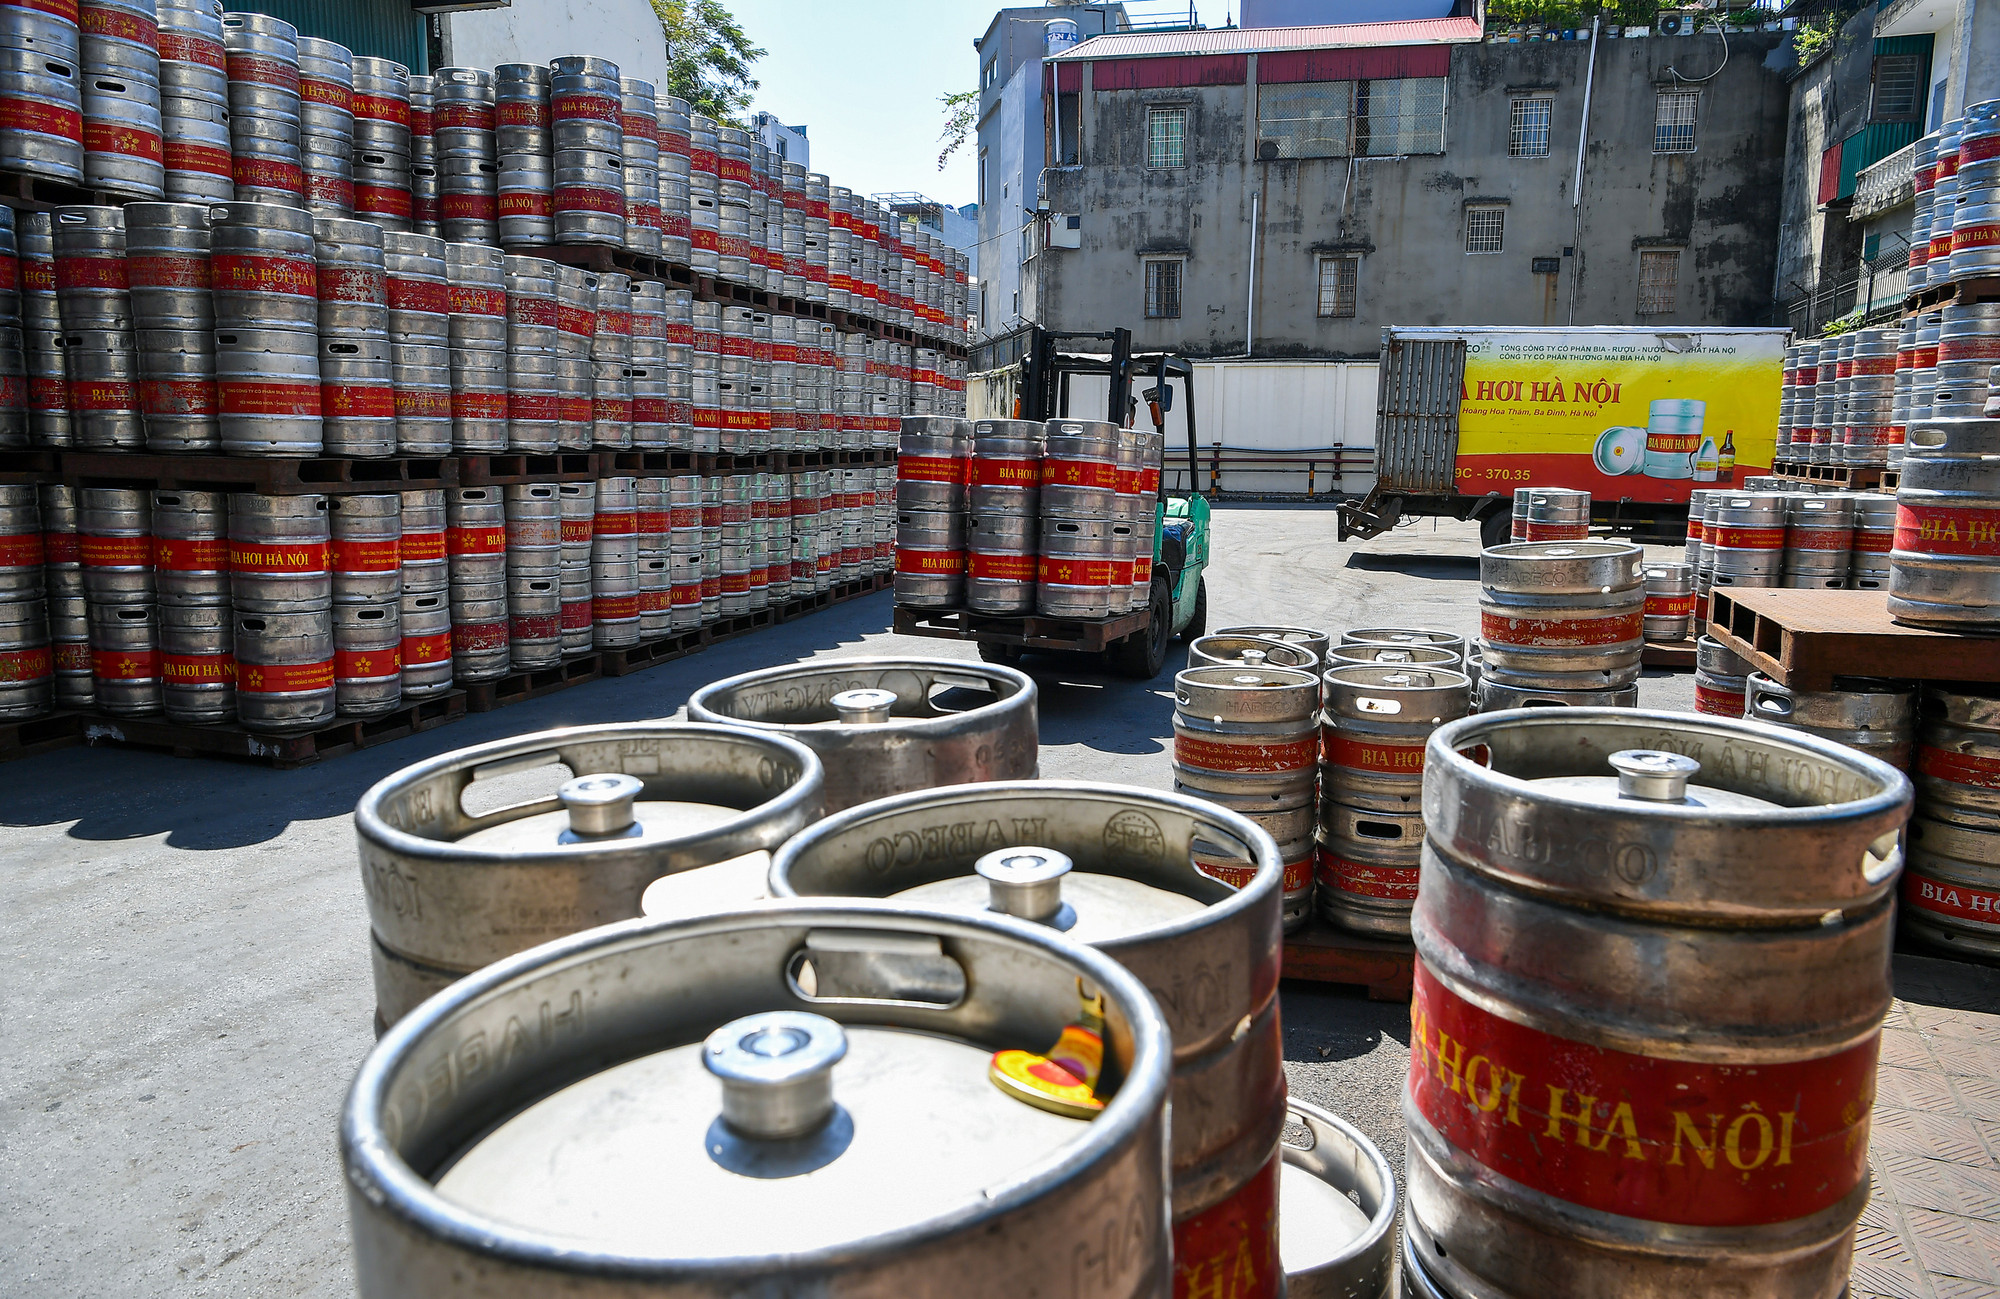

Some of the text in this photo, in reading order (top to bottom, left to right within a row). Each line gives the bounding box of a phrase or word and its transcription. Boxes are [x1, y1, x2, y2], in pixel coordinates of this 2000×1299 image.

[369, 103, 389, 115] NỘI
[516, 197, 534, 209] NỘI
[233, 267, 256, 281] BIA
[1500, 344, 1520, 352] TỔNG
[1523, 344, 1544, 352] CÔNG
[92, 389, 115, 402] BIA
[1476, 380, 1523, 402] HƠI
[1530, 376, 1567, 402] HÀ
[1573, 377, 1622, 409] NỘI
[1583, 410, 1598, 419] Nội
[1648, 437, 1659, 449] BIA
[1000, 467, 1032, 479] BIA HƠI
[1486, 468, 1531, 481] 370.35
[1919, 518, 1960, 543] BIA
[487, 535, 501, 546] BIA
[243, 551, 262, 565] HƠI
[266, 550, 284, 566] HÀ
[287, 551, 309, 568] NỘI
[922, 557, 938, 568] BIA
[1668, 603, 1682, 612] BIA
[178, 664, 200, 677] HƠI
[203, 661, 221, 677] HÀ
[1362, 748, 1390, 767] BIA
[1921, 881, 1963, 908] BIA
[1438, 1028, 1526, 1127] HƠI
[1666, 1101, 1797, 1181] NỘI
